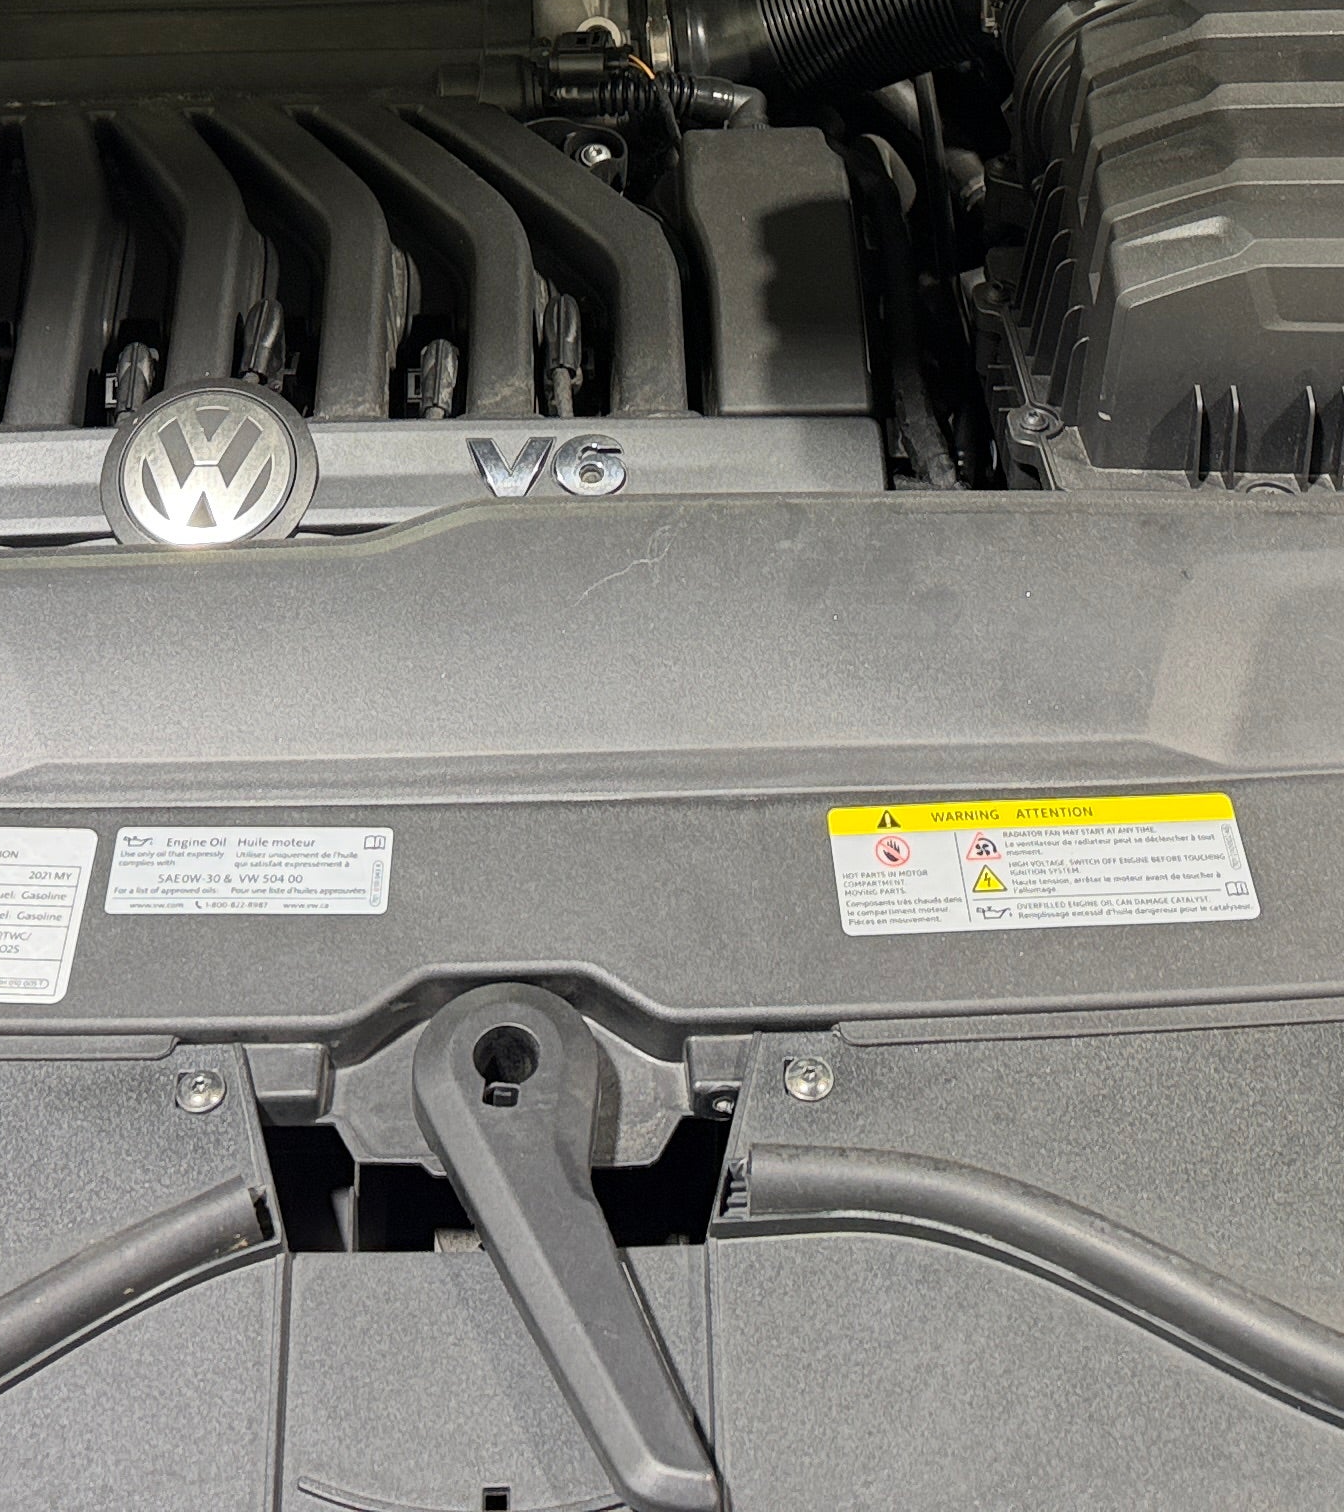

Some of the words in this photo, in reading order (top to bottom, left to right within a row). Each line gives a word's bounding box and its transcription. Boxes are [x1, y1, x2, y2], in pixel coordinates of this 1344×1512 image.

[465, 433, 628, 498] V6
[931, 809, 1000, 823] WARNING
[1016, 806, 1093, 819] ATTENTION
[1003, 830, 1043, 838] RADIATOR
[167, 837, 207, 849] Engine
[210, 837, 227, 847] Oil
[237, 837, 269, 847] Huile
[271, 838, 316, 847] moteur
[138, 851, 155, 859] only
[187, 851, 224, 859] expressly
[28, 871, 51, 880] 2021
[53, 871, 72, 880] MY
[223, 873, 232, 884] &
[239, 874, 259, 884] VW
[262, 874, 285, 884] 504
[287, 874, 303, 884] 00
[21, 890, 68, 901] Gasoline
[161, 887, 199, 895] approved
[1134, 897, 1168, 905] DAMAGE
[16, 911, 63, 921] Gasoline
